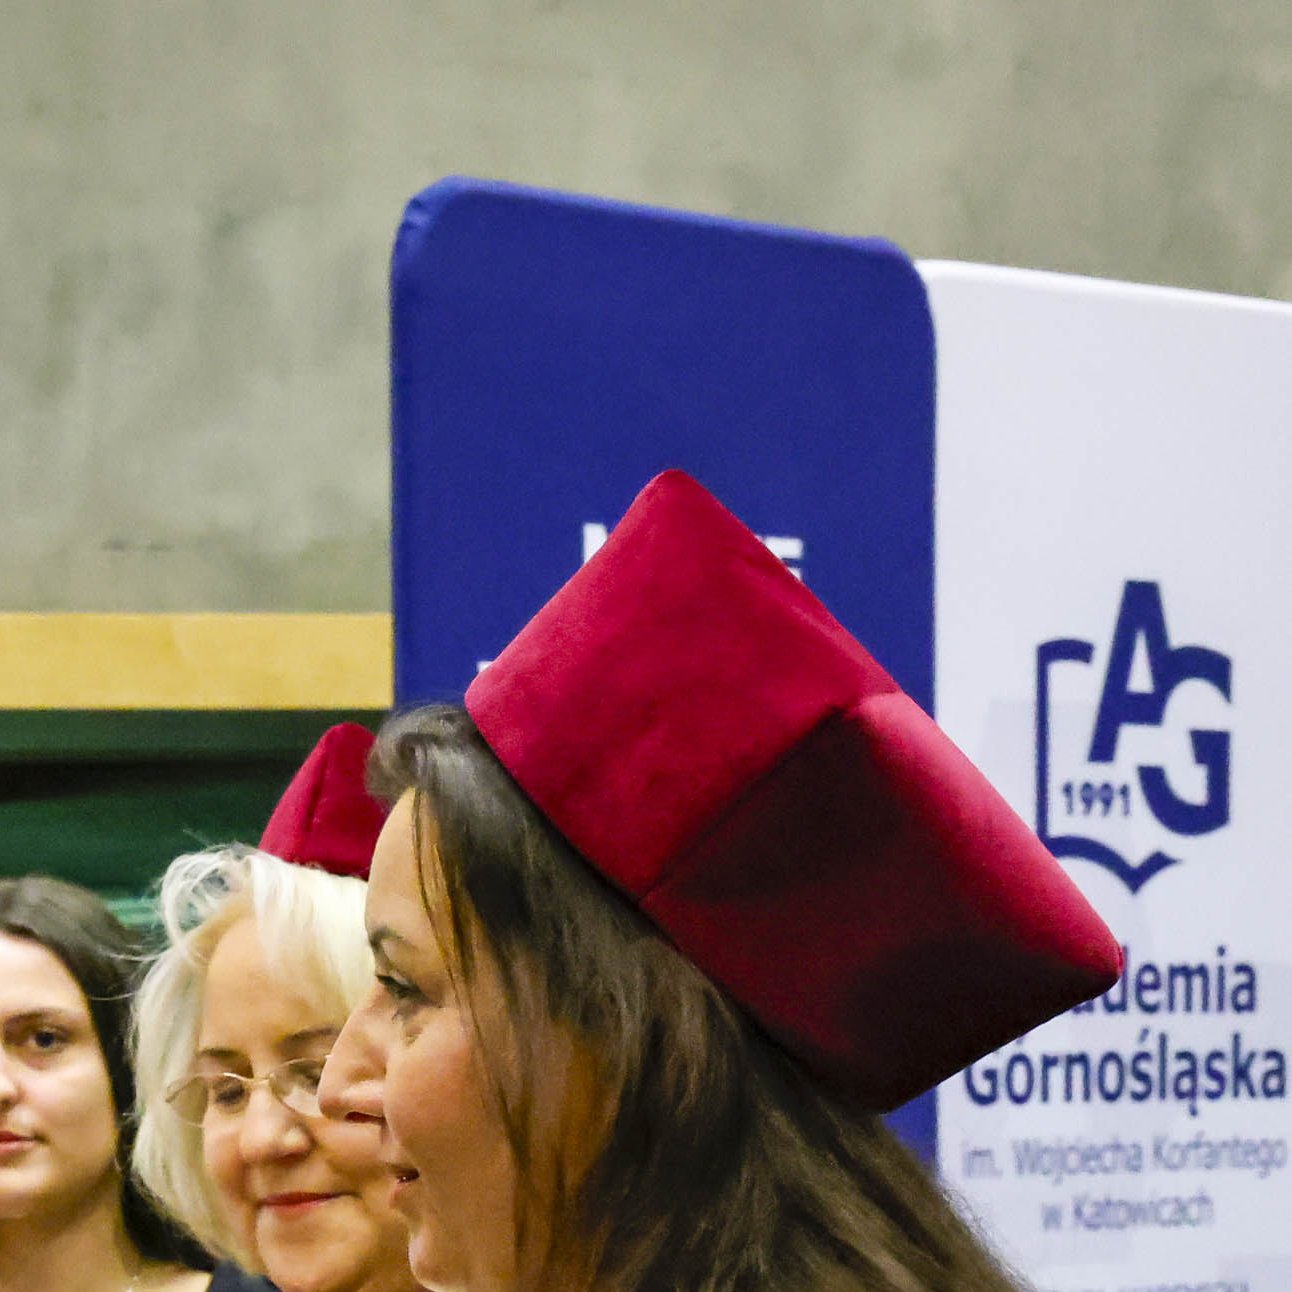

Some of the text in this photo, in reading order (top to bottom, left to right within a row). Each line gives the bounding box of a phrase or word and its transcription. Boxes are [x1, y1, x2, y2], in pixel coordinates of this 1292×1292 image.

[1061, 781, 1132, 818] 1991
[1071, 944, 1257, 1014] demia
[962, 1028, 1287, 1118] Górnośląska
